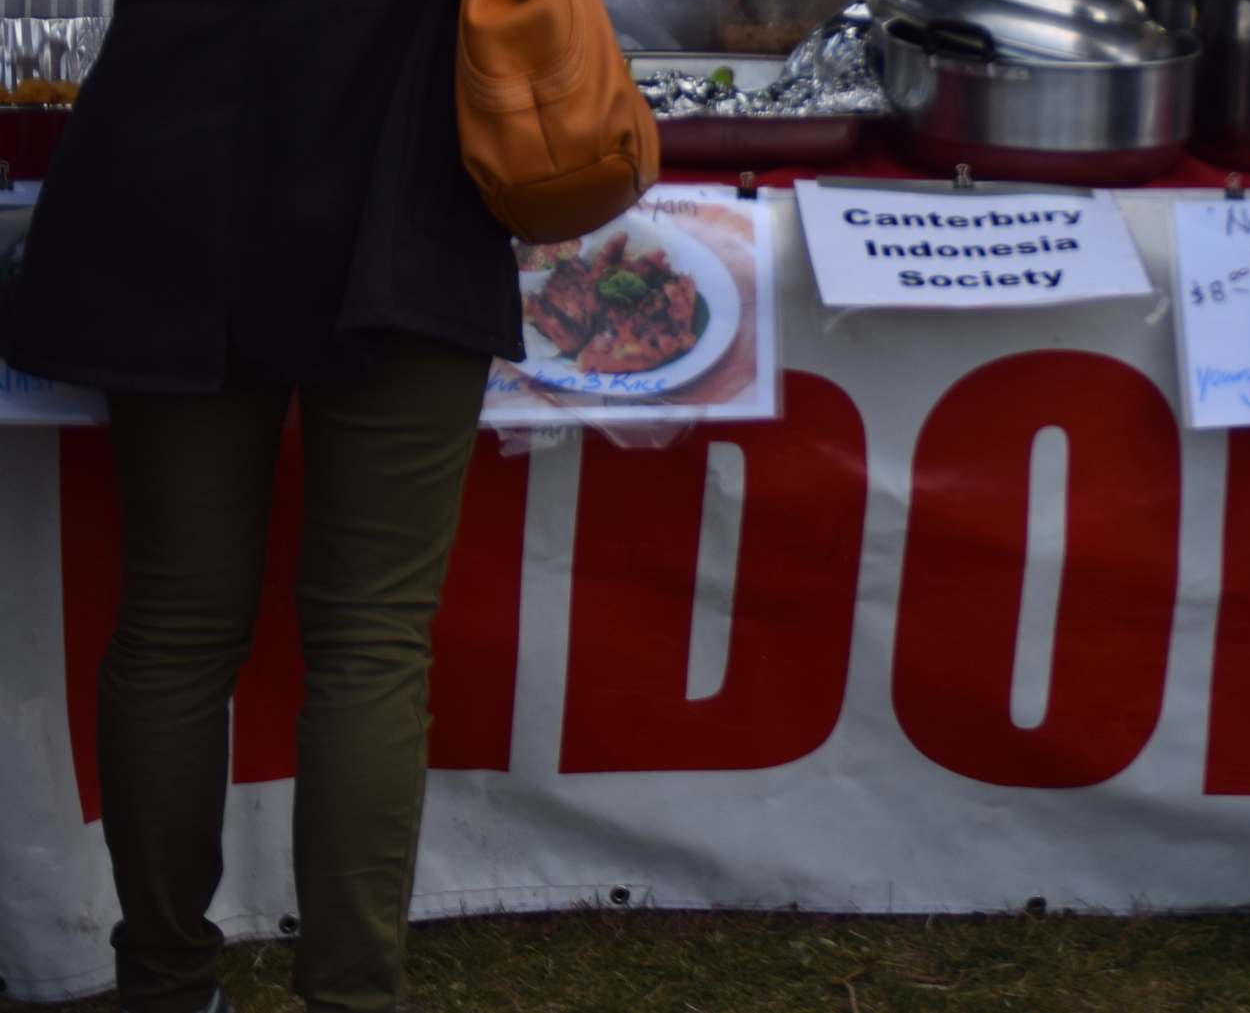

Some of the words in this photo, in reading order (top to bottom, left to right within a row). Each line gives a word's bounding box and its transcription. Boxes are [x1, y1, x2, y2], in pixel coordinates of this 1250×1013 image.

[843, 208, 1082, 227] Canterbury
[865, 235, 1079, 257] Indonesia
[898, 268, 1063, 287] Society
